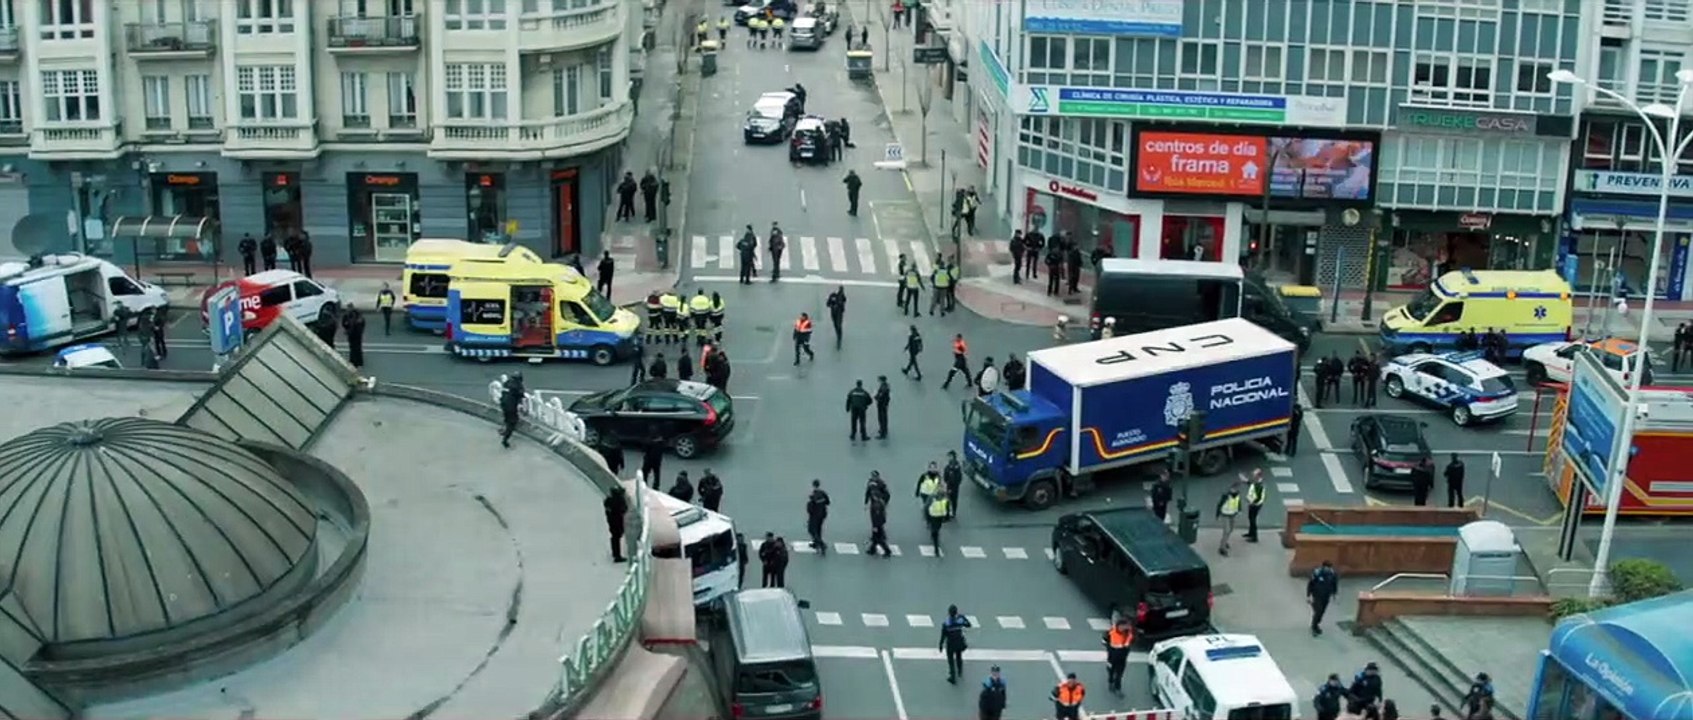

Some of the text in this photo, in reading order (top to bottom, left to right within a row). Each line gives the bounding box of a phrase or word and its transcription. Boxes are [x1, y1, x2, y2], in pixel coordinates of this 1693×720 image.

[1103, 92, 1113, 100] DE
[1145, 139, 1204, 153] centros
[1209, 140, 1229, 155] de
[1171, 154, 1230, 174] frama
[1607, 174, 1690, 189] PREVENIVA
[224, 310, 234, 336] P
[1096, 333, 1234, 365] CNP
[1209, 386, 1289, 410] NACIONAL
[1585, 652, 1598, 669] La
